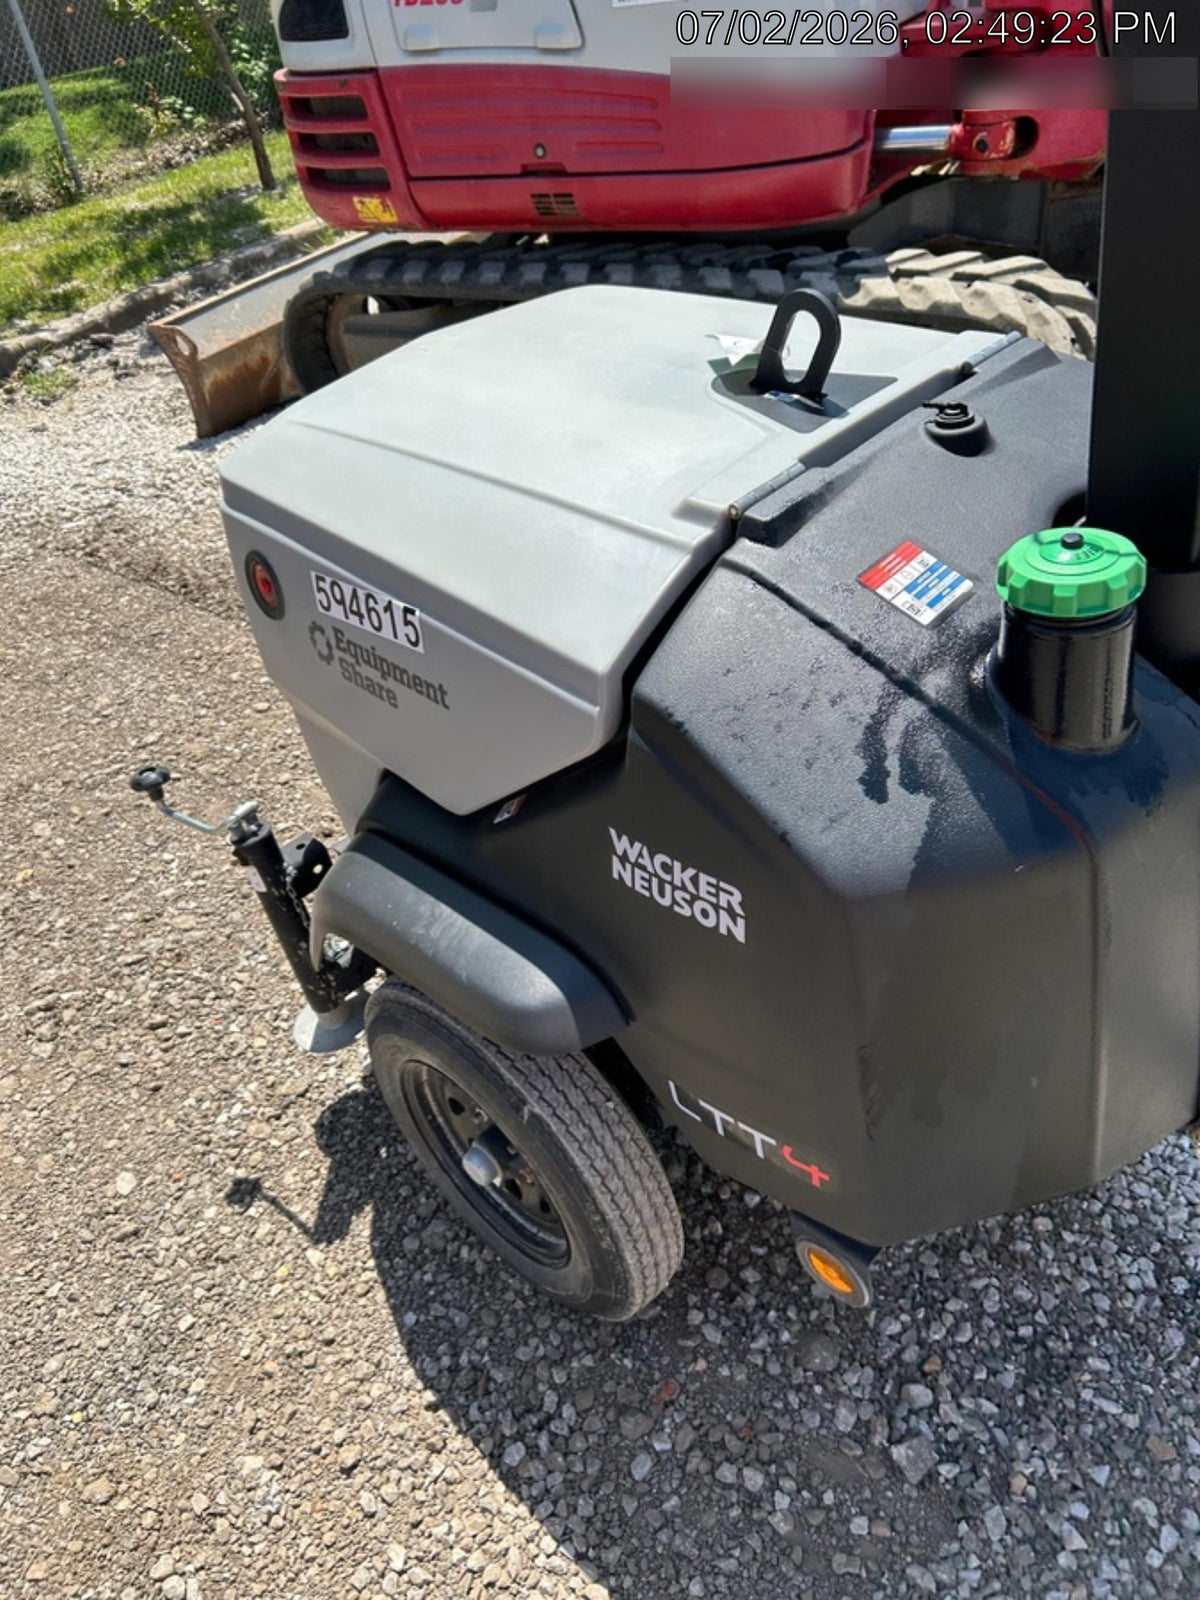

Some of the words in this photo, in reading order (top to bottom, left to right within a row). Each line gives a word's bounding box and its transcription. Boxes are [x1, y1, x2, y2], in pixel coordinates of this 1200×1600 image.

[314, 573, 421, 649] 594615
[331, 625, 450, 710] Equipment
[338, 657, 399, 709] Share
[608, 826, 746, 917] WACKER
[611, 854, 746, 944] NEUSON
[667, 1079, 830, 1188] LTT4
